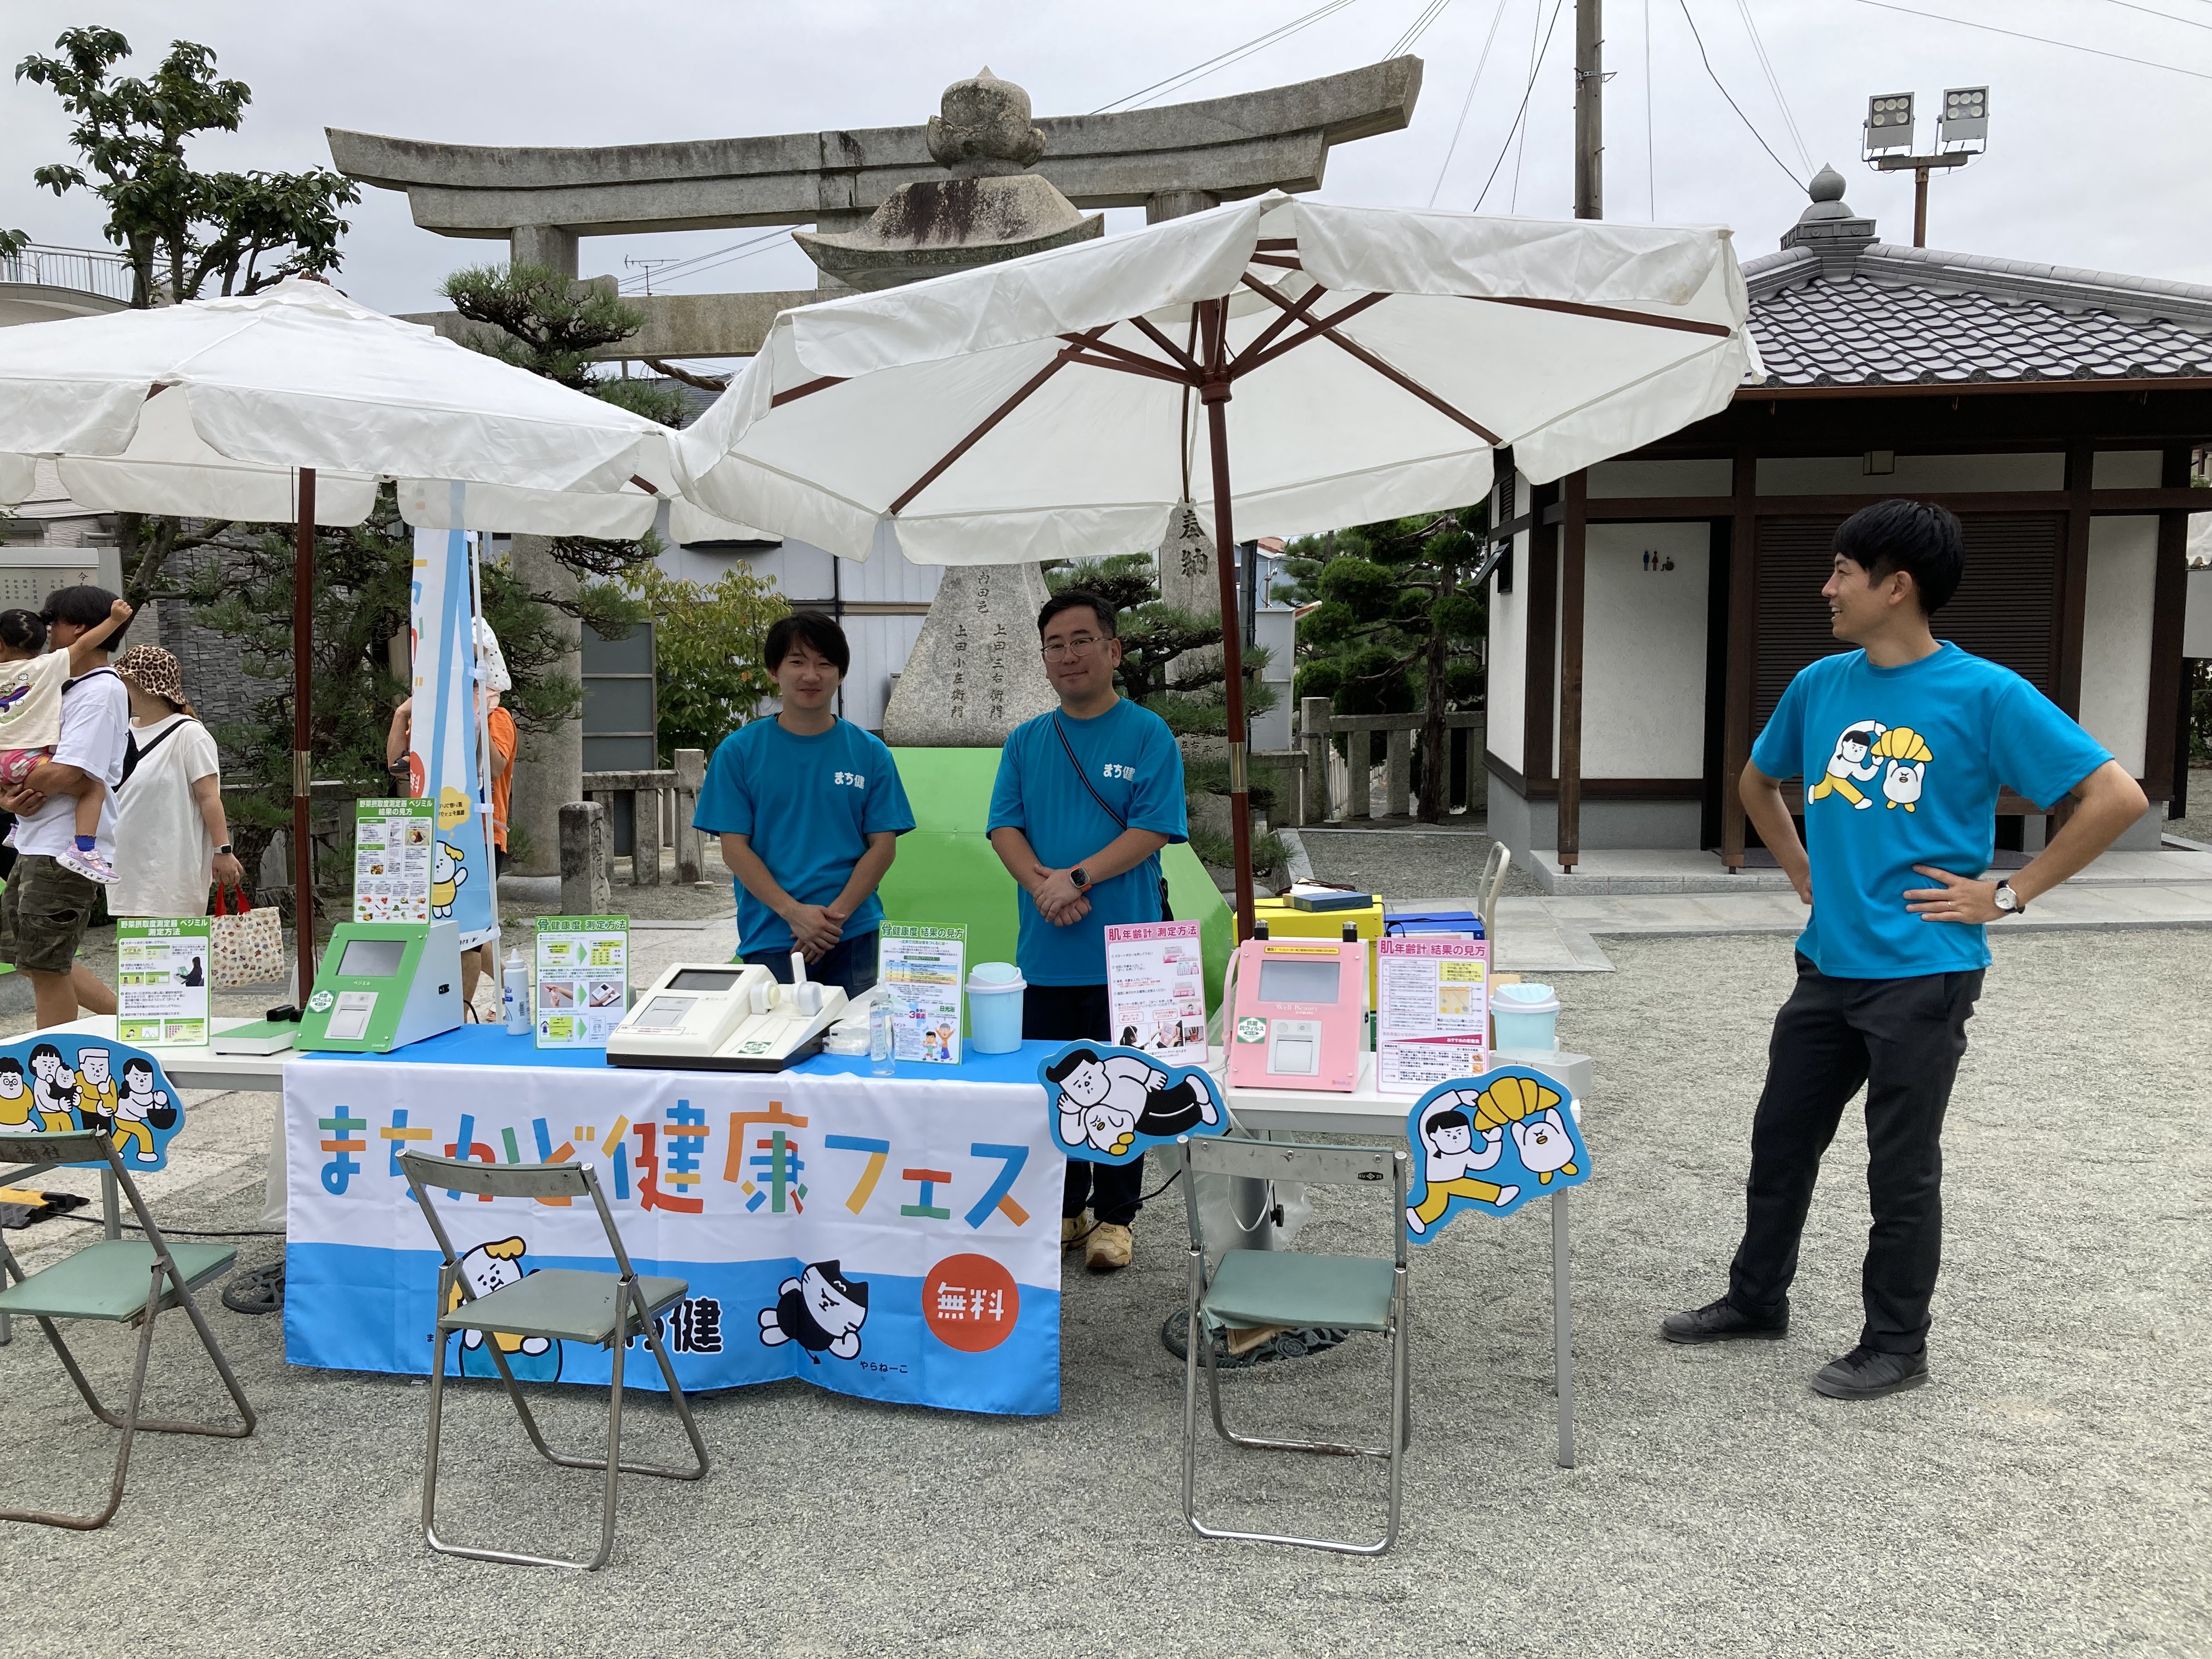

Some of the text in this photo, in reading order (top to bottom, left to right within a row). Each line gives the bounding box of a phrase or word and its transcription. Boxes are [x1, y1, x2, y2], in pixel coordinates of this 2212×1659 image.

[1180, 509, 1208, 578] 奉納
[834, 771, 865, 789] まち健
[1103, 763, 1136, 781] まち健
[120, 919, 178, 928] 野菜摂取度測定器
[538, 918, 627, 931] 骨健康度 測定方法
[882, 923, 964, 939] 骨健康度 結果の見方
[148, 928, 180, 936] 測定方法
[1108, 926, 1197, 941] 肌年齢計 測定方法
[1380, 940, 1486, 956] 肌年齢計 結果の見方
[318, 1099, 1031, 1229] まちかど健康フェス
[938, 1282, 1004, 1321] 無料
[860, 1360, 909, 1373] やらねーこ
